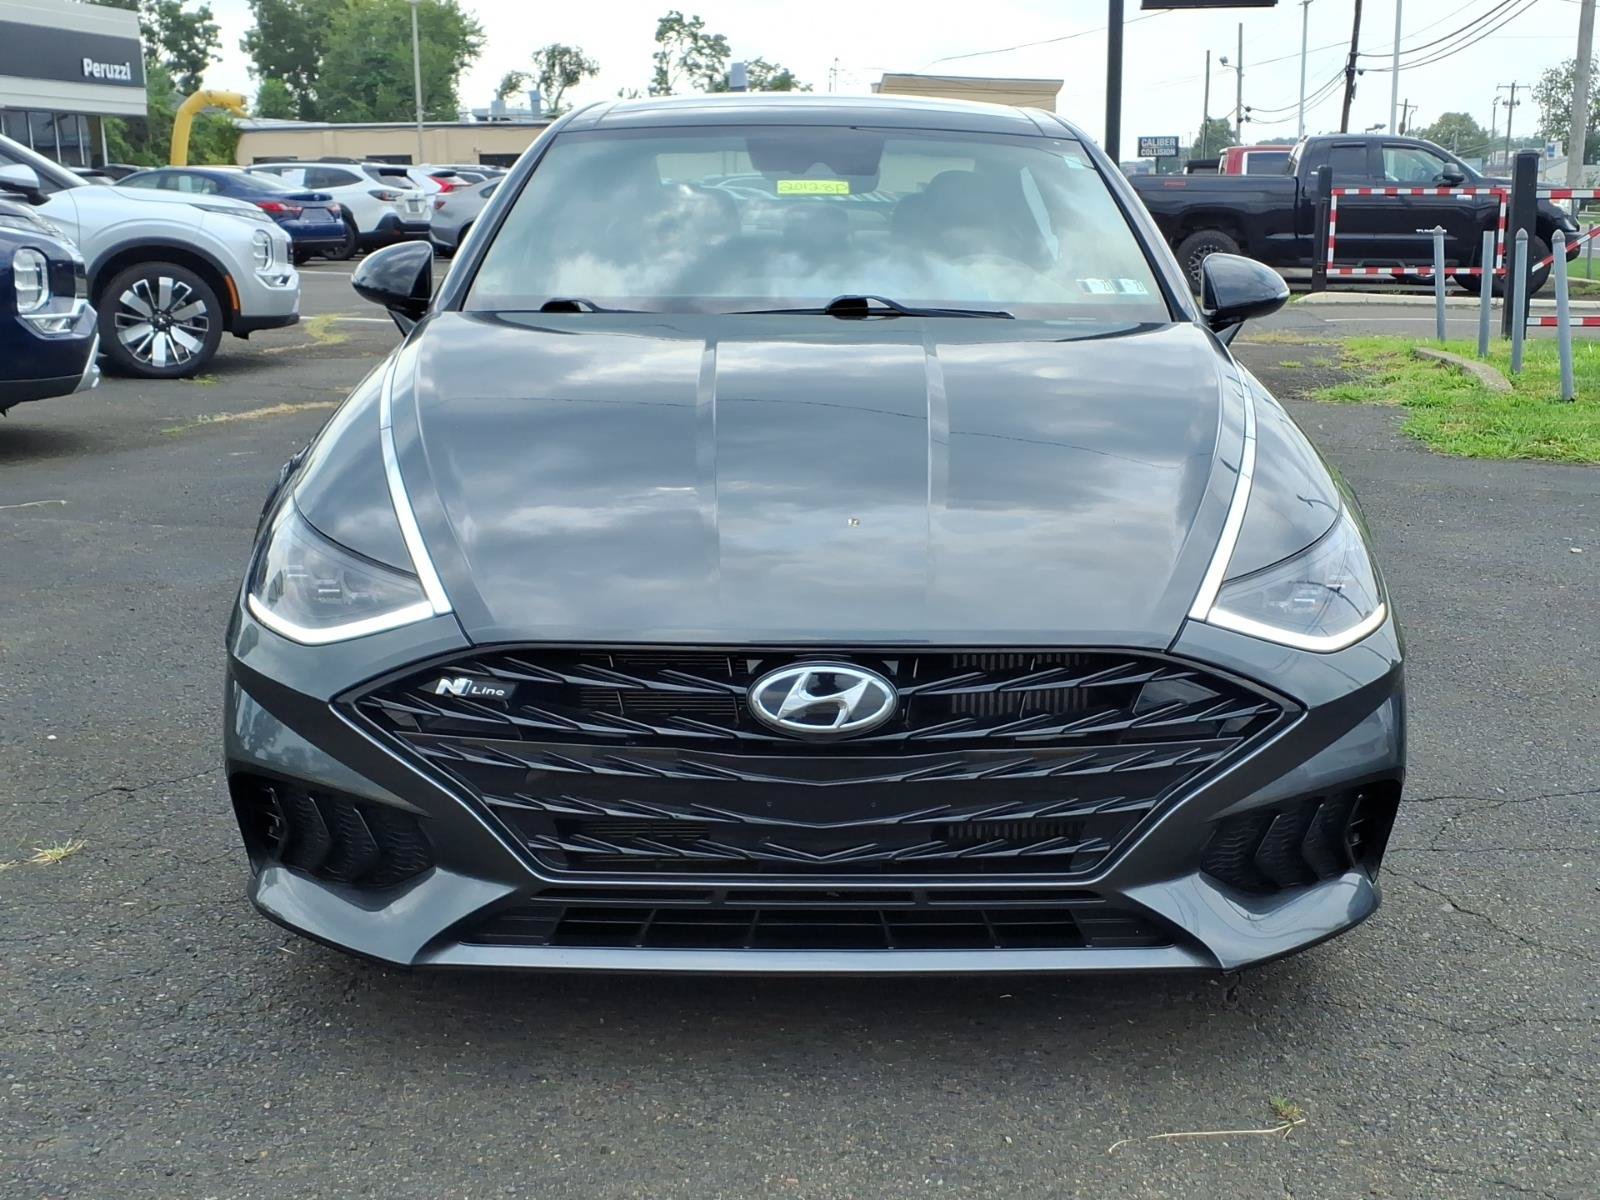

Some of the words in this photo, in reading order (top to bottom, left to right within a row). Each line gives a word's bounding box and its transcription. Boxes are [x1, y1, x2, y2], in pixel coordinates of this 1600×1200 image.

[83, 57, 131, 80] Peruzzi
[1141, 137, 1176, 147] CALIBER
[1141, 148, 1176, 156] COLLISION
[435, 678, 472, 696] N
